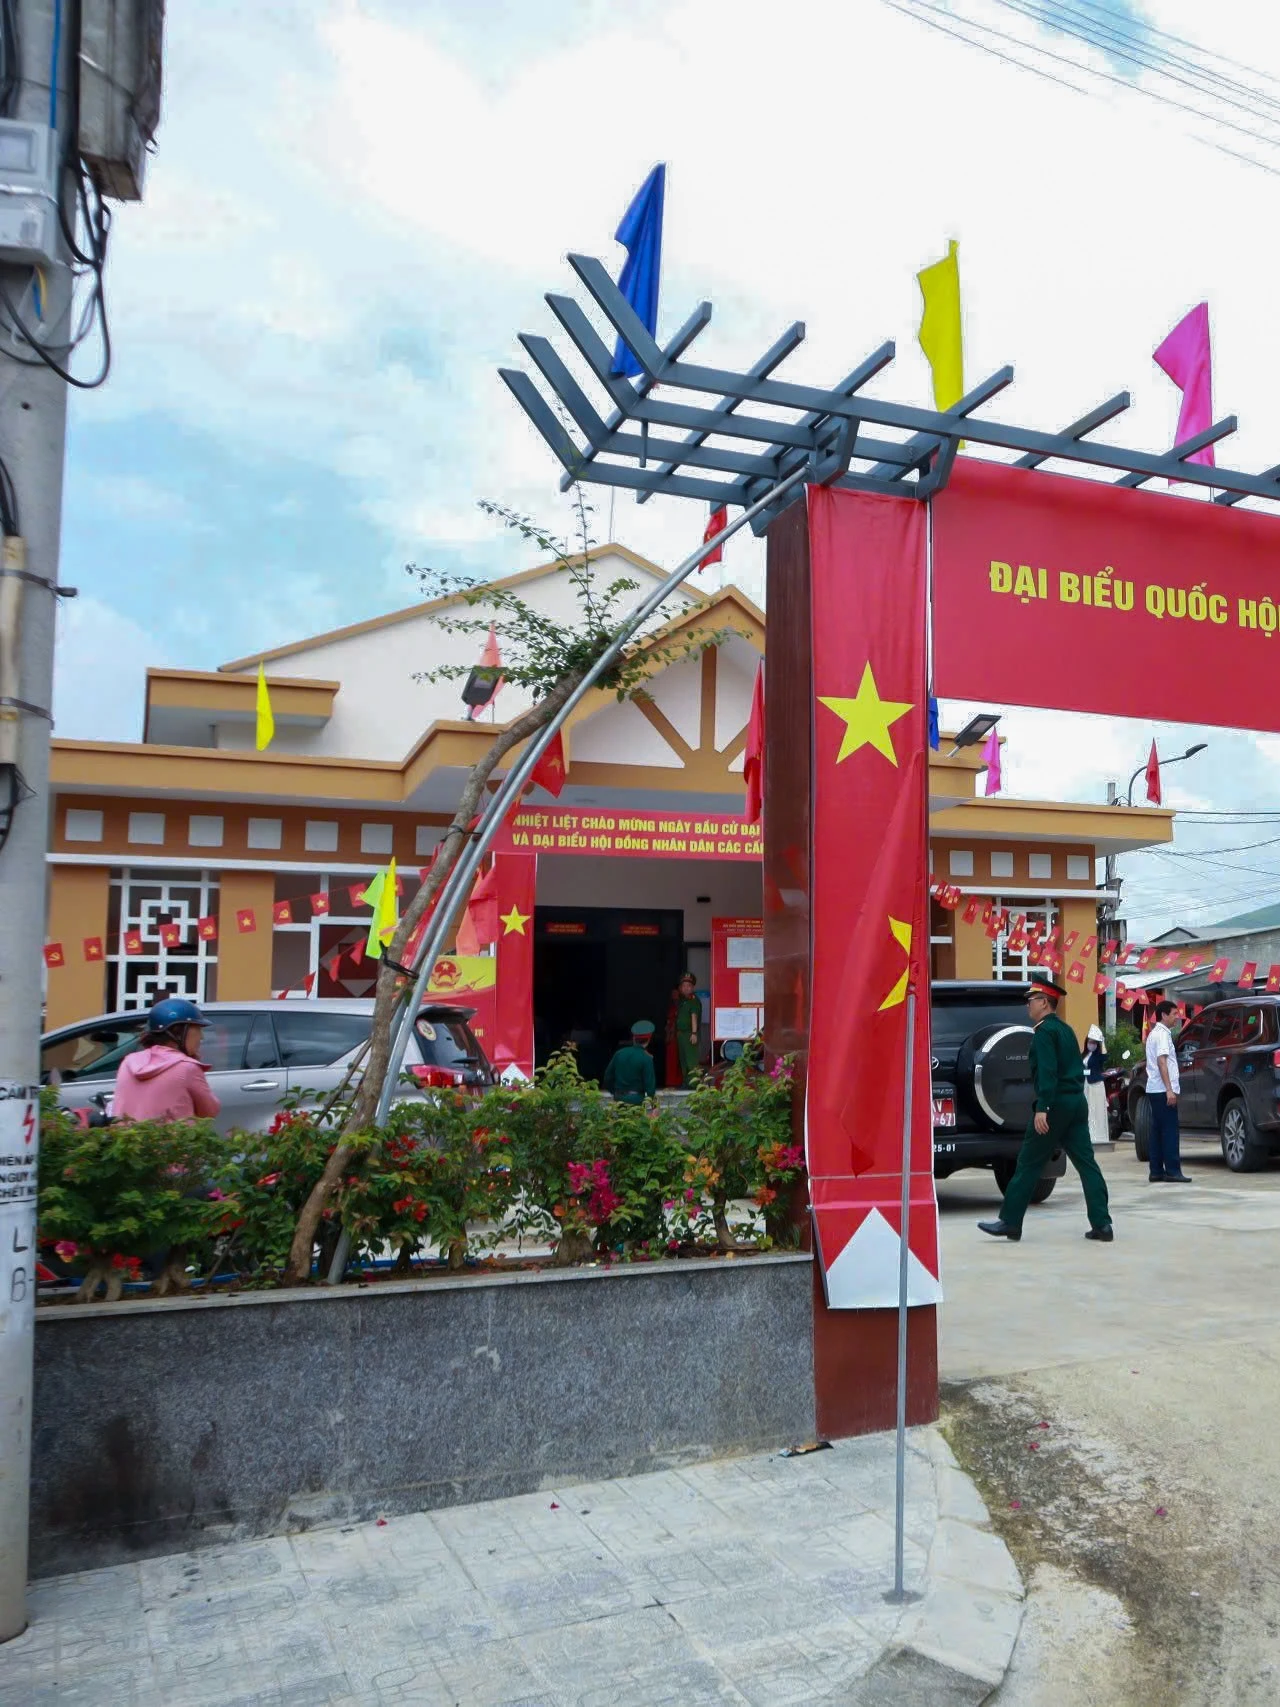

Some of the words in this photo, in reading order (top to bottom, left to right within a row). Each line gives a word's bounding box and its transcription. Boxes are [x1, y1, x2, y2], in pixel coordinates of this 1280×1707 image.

[989, 560, 1048, 604] ĐẠI
[1059, 565, 1134, 611] BIỂU
[1145, 582, 1229, 624] QUỐC
[552, 814, 578, 830] LIỆT
[581, 816, 615, 831] CHÀO
[618, 816, 655, 832] MỪNG
[658, 819, 691, 833] NGÀY
[740, 823, 760, 839] ĐẠI
[512, 831, 529, 846] VÀ
[533, 833, 554, 849] ĐẠI
[590, 834, 612, 851] HỘI
[652, 838, 687, 852] NHÂN
[689, 839, 715, 853] DÂN
[717, 840, 741, 854] CÁC
